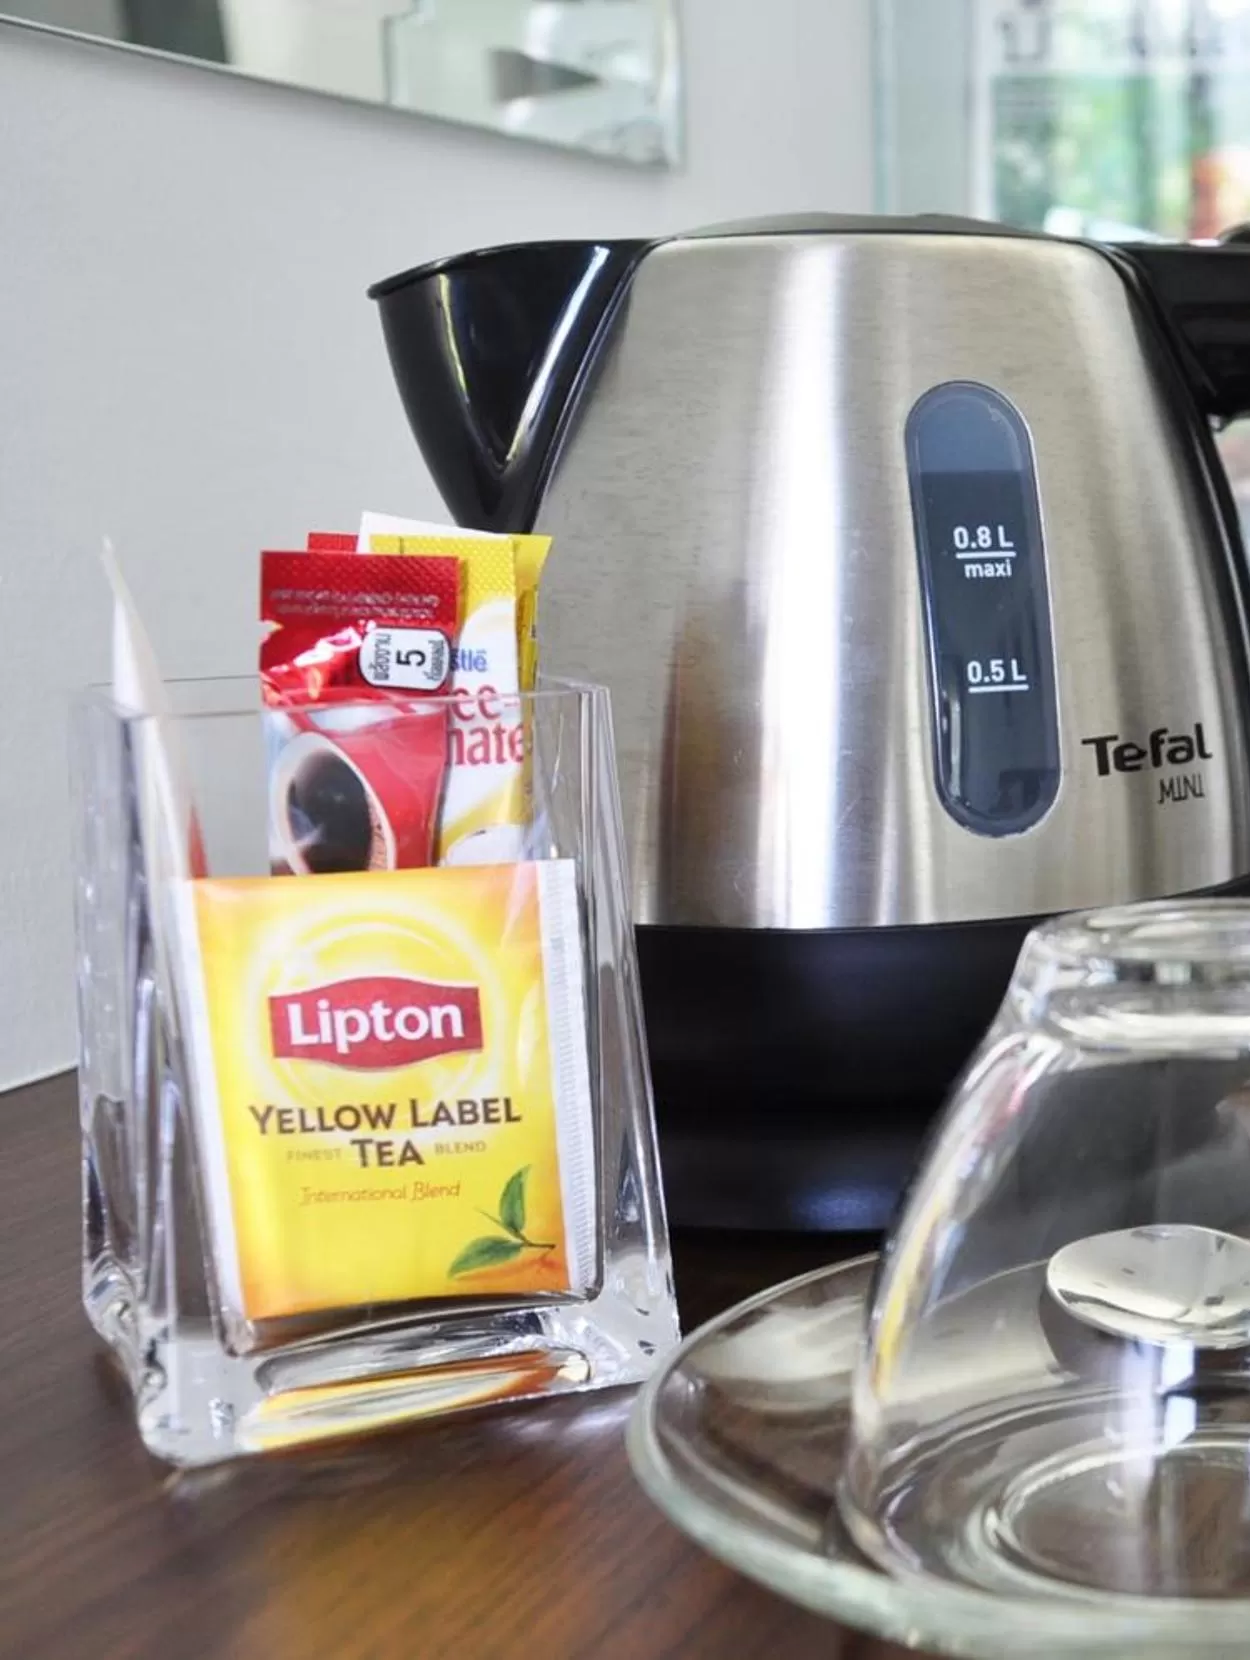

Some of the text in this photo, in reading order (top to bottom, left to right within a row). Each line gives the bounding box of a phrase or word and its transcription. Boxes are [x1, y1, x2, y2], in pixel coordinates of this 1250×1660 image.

[953, 524, 1014, 549] 0.8 L
[964, 558, 1013, 579] maxi
[396, 649, 426, 667] 5
[966, 658, 1027, 684] 0.5 L
[1081, 722, 1213, 777] Tefal
[1158, 774, 1205, 805] MINI
[287, 1000, 464, 1054] Lipton
[250, 1097, 522, 1134] YELLOW LABEL
[287, 1138, 487, 1168] FINEST TEA BLEND
[299, 1180, 461, 1206] International Blend
